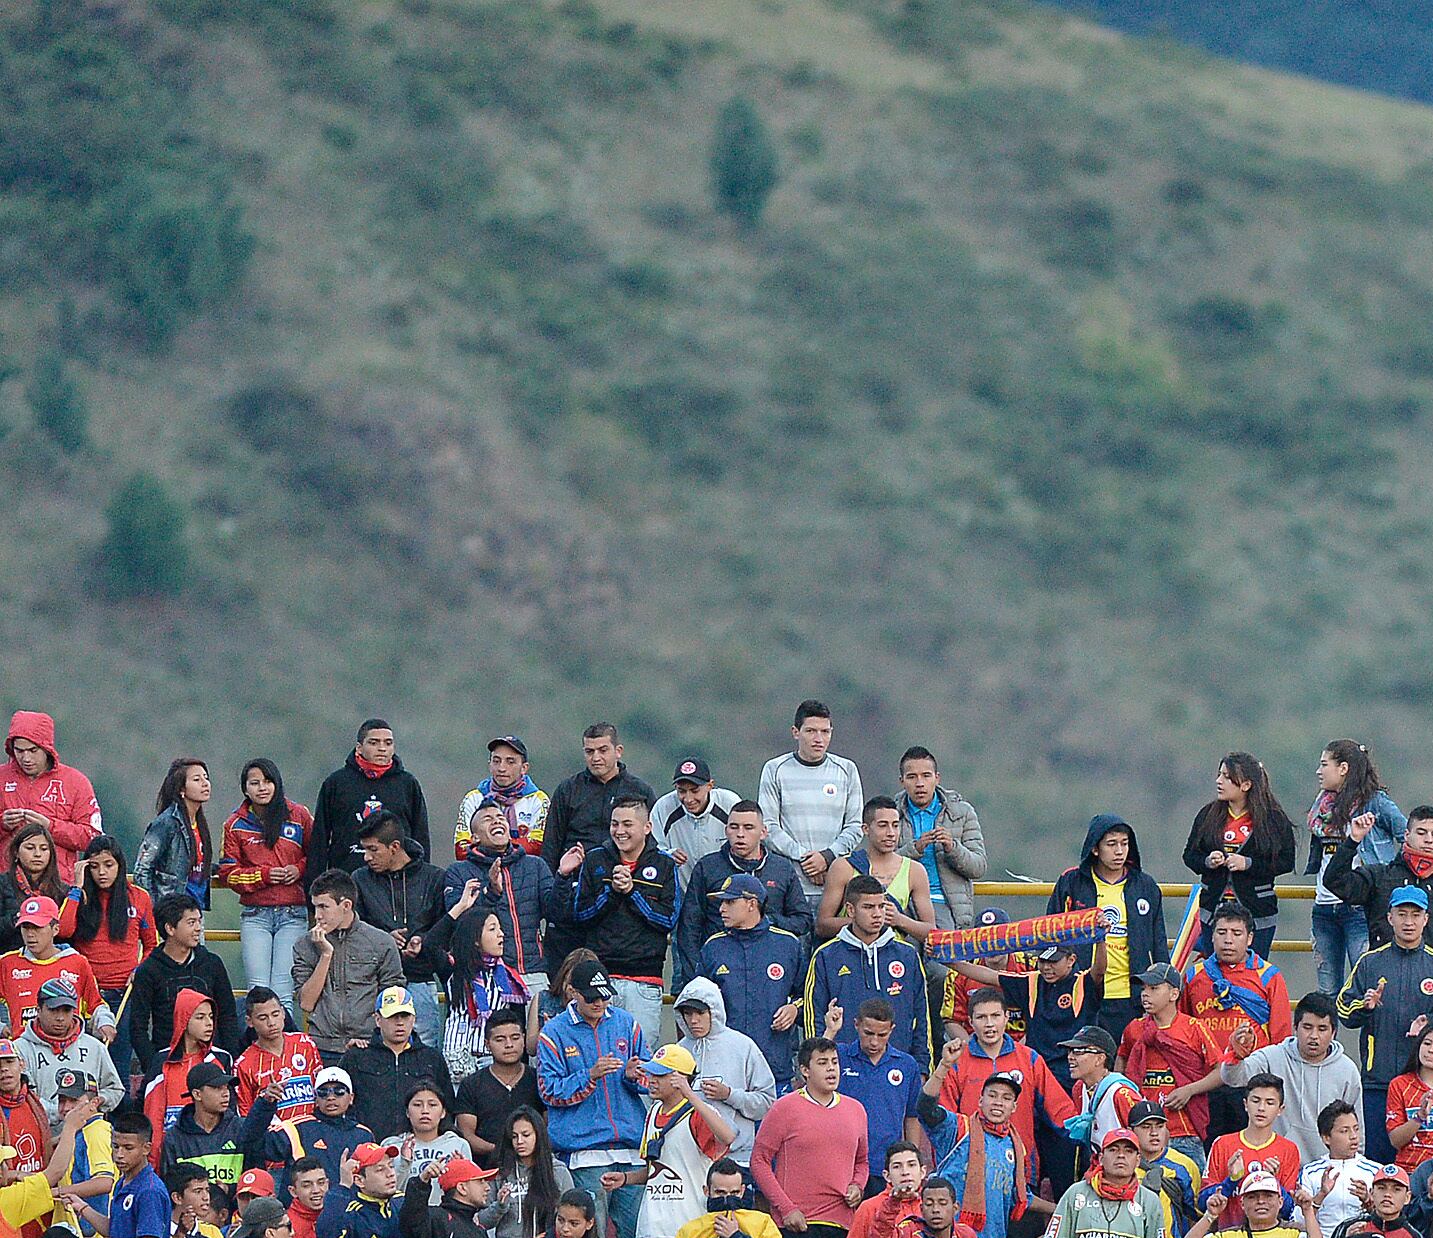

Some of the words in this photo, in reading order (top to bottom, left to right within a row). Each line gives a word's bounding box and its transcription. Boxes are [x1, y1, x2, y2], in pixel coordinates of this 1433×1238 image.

[961, 920, 1022, 957] MALA
[1026, 910, 1100, 948] JUNTA
[38, 1053, 50, 1069] A
[57, 1050, 70, 1062] &
[79, 1047, 89, 1062] F
[280, 1082, 313, 1104] ARIÑO
